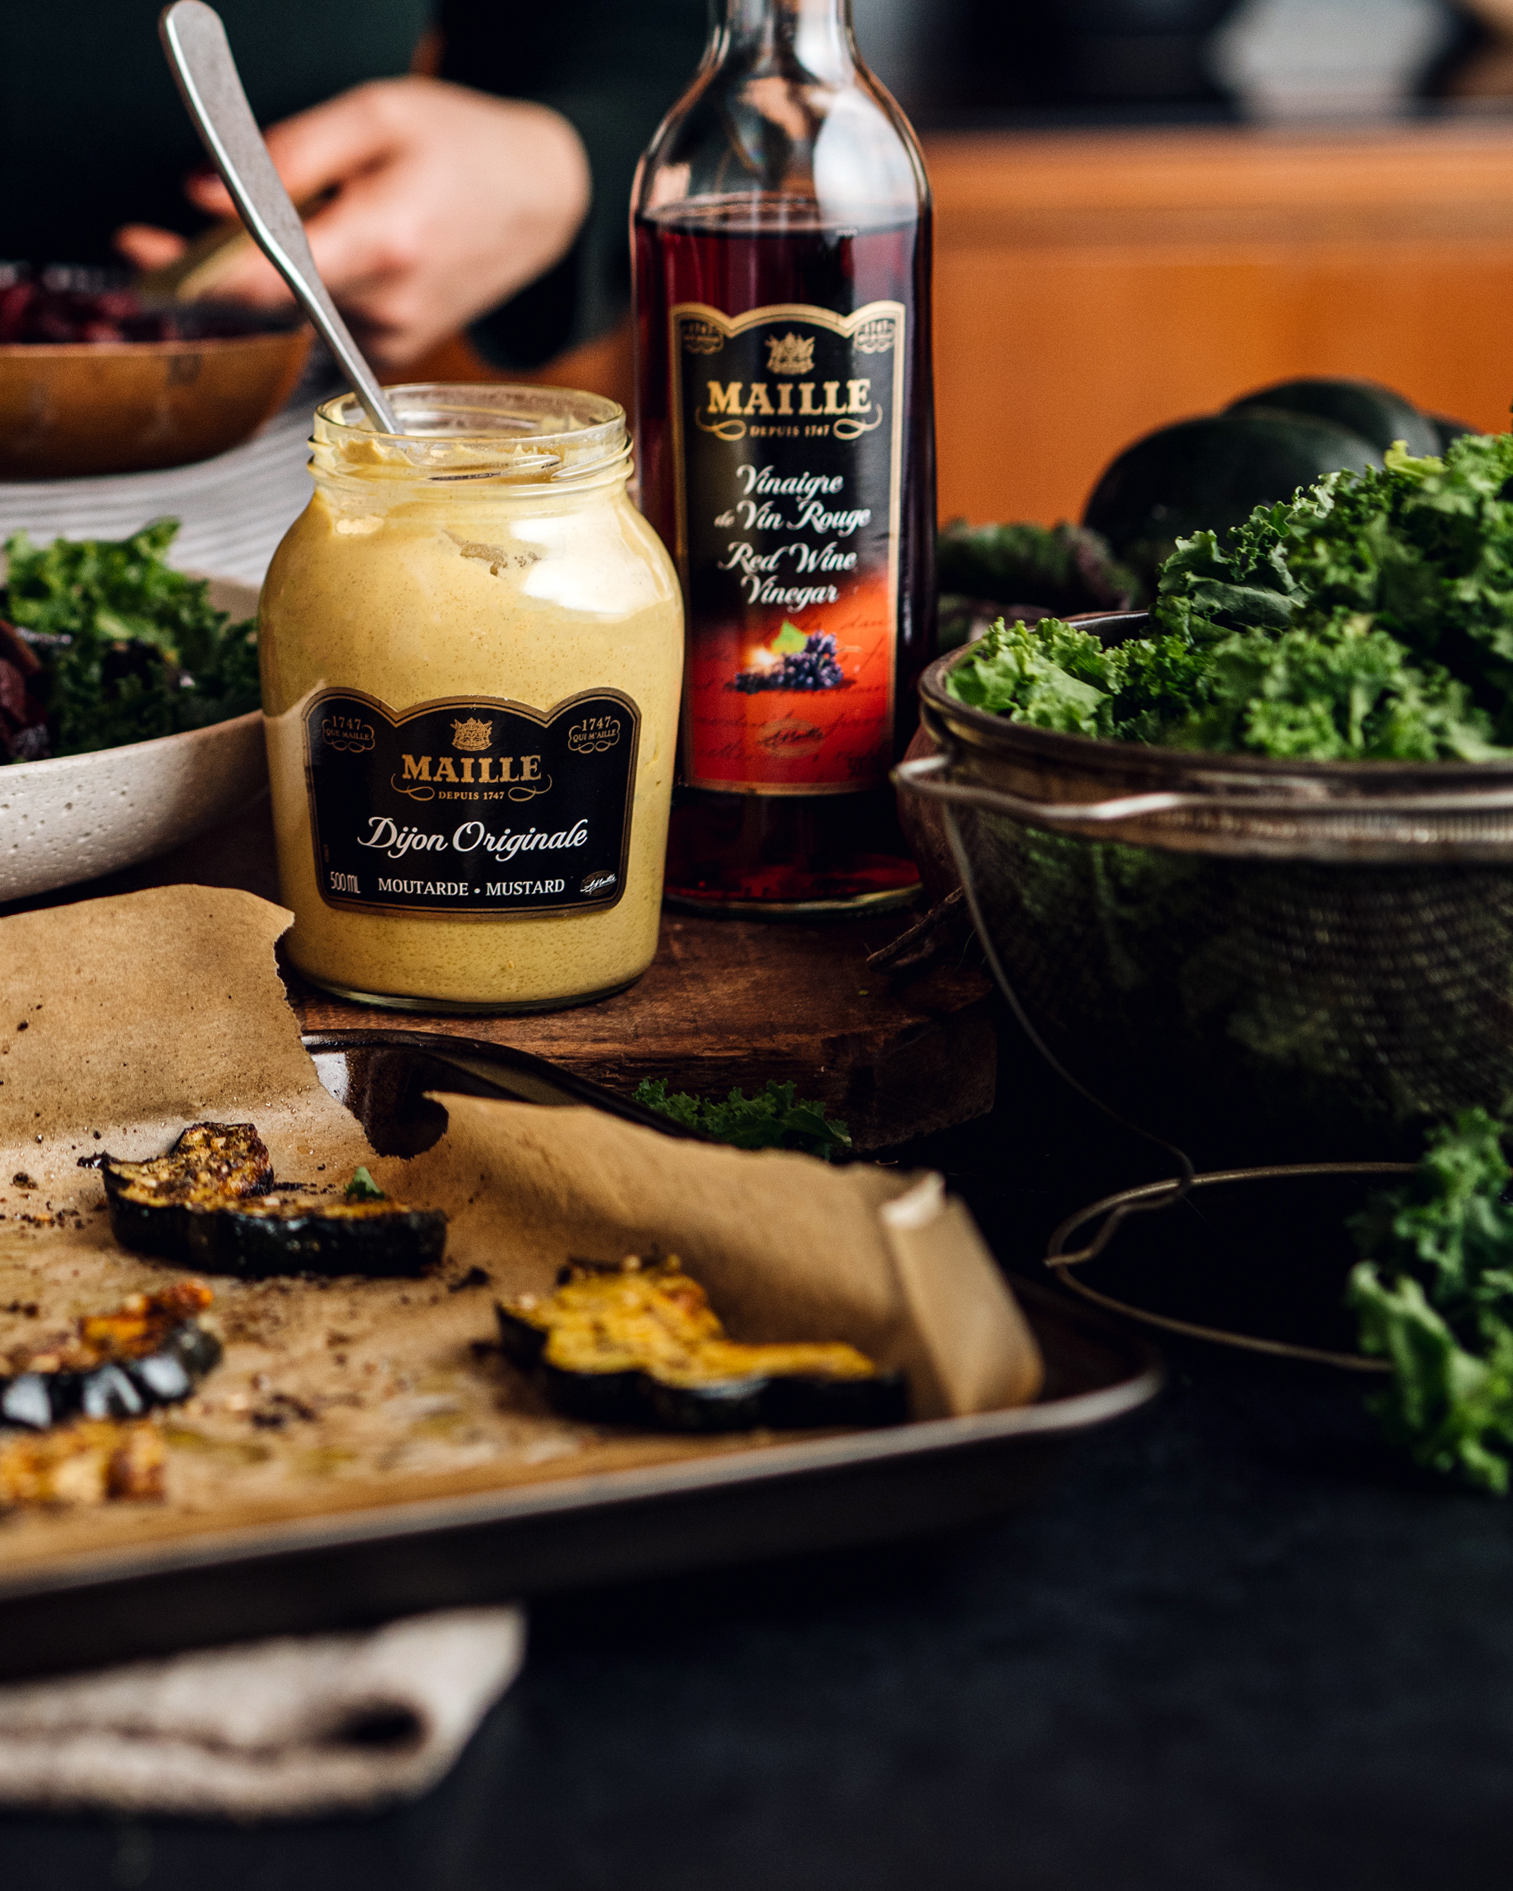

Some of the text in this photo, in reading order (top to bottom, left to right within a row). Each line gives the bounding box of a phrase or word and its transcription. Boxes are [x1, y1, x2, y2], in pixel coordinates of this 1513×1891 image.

[707, 377, 872, 416] MAILLE
[749, 424, 800, 438] DEPUIS
[736, 464, 844, 503] Vinaigre
[714, 499, 872, 538] de Vin Rouge
[717, 541, 858, 575] Red Wine
[740, 574, 841, 614] Vinegar
[326, 727, 371, 741] QUE MAILLE
[332, 715, 362, 731] 1747
[581, 715, 612, 732] 1747
[572, 733, 587, 743] QUI
[401, 754, 542, 784] MAILLE
[438, 791, 505, 801] DEPUIS 1747
[357, 816, 448, 859] Dijon
[452, 819, 589, 862] Originale
[378, 877, 469, 896] MOUTARDE
[486, 878, 566, 896] MUSTARD
